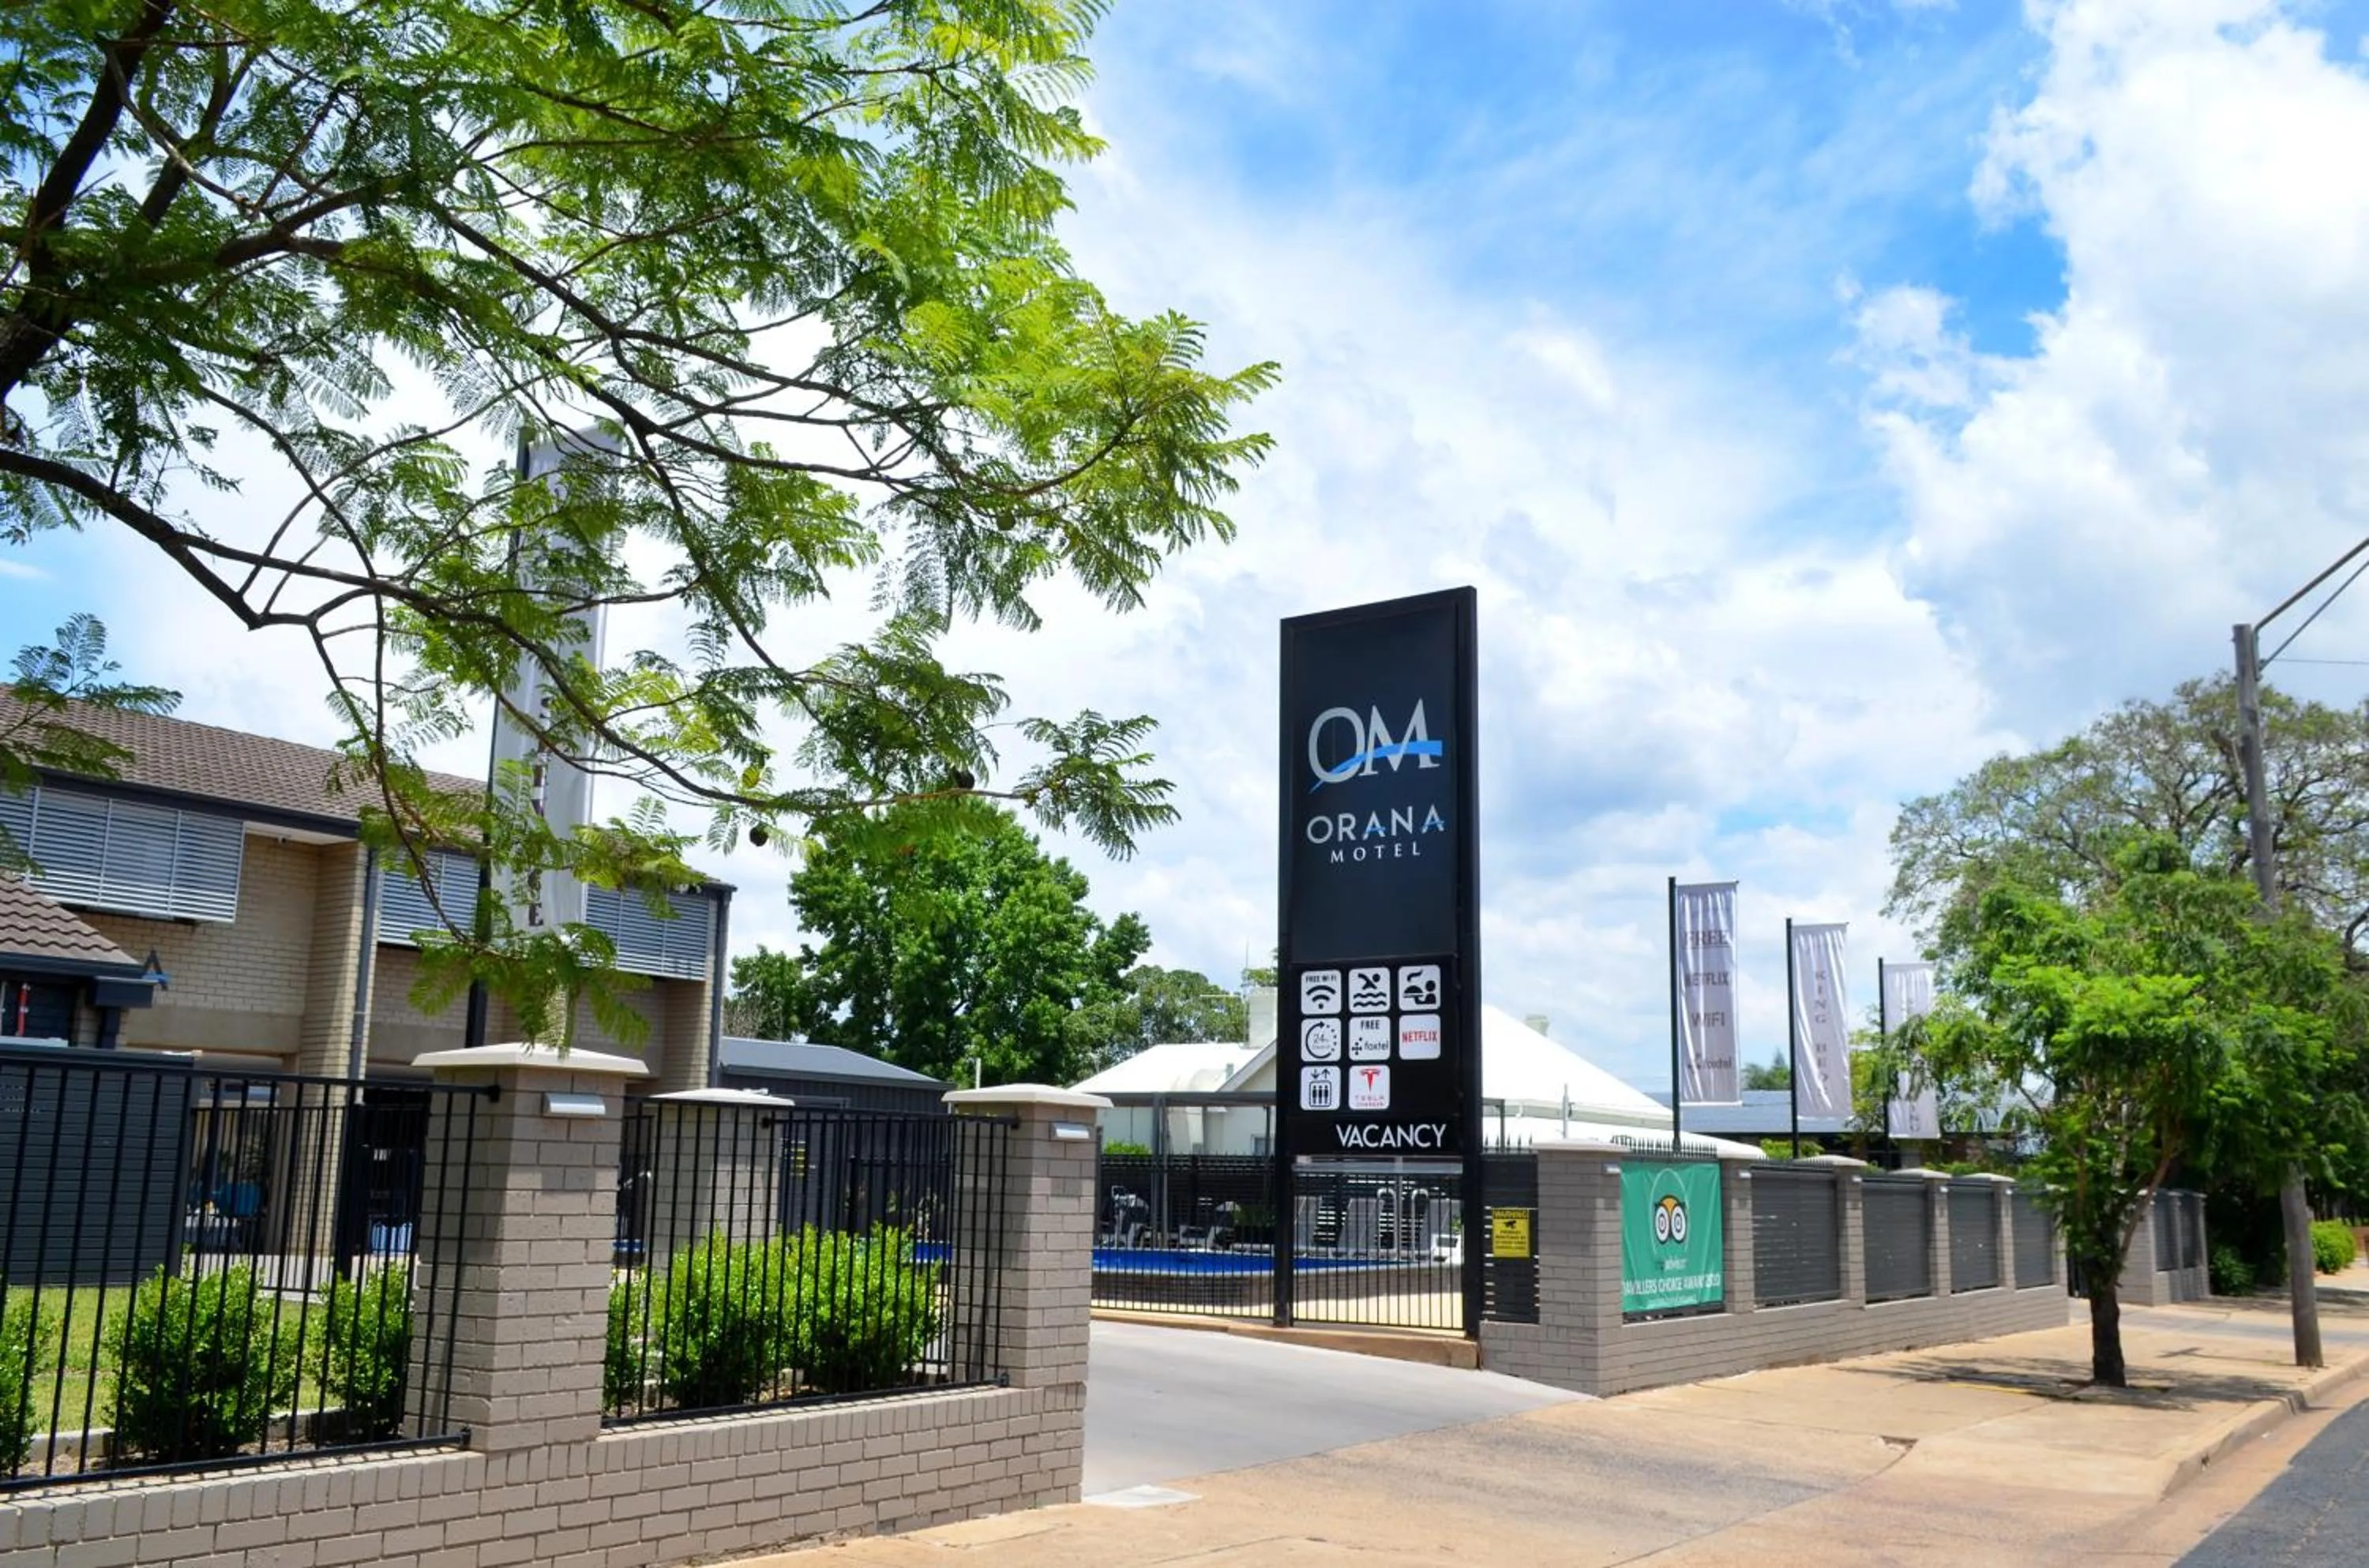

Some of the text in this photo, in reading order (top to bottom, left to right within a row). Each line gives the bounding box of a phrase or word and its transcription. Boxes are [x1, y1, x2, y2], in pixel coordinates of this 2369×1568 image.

[1308, 697, 1441, 783] OM
[1306, 803, 1444, 844] ORANA
[1331, 841, 1421, 864] MOTEL
[1684, 929, 1729, 946] FREE
[1685, 971, 1729, 986] NETFLIX
[1361, 1019, 1380, 1030] FREE
[1691, 1011, 1725, 1027] WIFI
[1402, 1030, 1438, 1043] NETFLIX
[1364, 1040, 1389, 1051] foxtel
[1335, 1123, 1447, 1149] VACANCY
